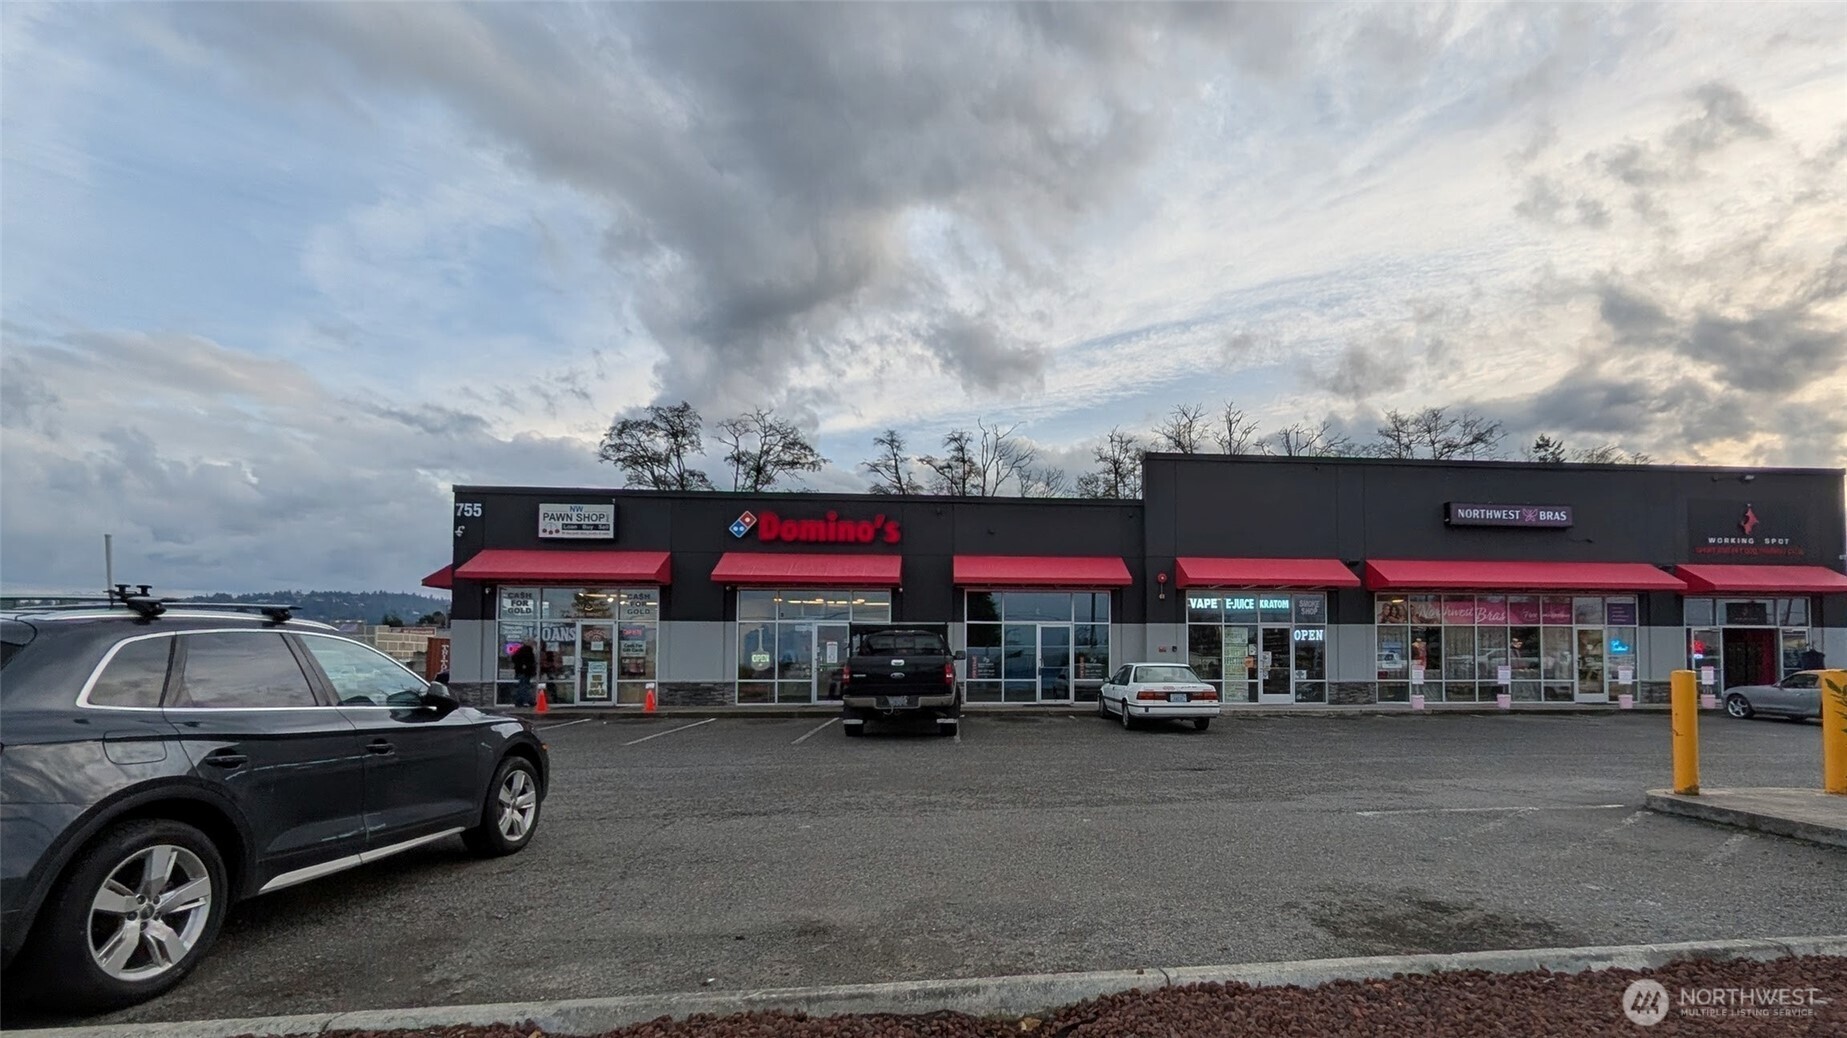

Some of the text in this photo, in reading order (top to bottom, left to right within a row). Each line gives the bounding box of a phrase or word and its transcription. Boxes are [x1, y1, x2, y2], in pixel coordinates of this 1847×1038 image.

[455, 502, 482, 517] 755
[1458, 508, 1567, 520] NORTHWEST BRAS
[543, 512, 573, 522] PAWN
[576, 513, 605, 522] SHOP
[759, 511, 900, 542] Domino's
[1190, 598, 1218, 609] VAPE
[1226, 598, 1254, 609] E-JUICE
[1299, 599, 1320, 607] SMOKE
[1301, 607, 1318, 615] SHOP
[1419, 604, 1506, 622] Norhwest Bras
[1294, 629, 1323, 641] OPEN
[751, 654, 770, 663] OPEN
